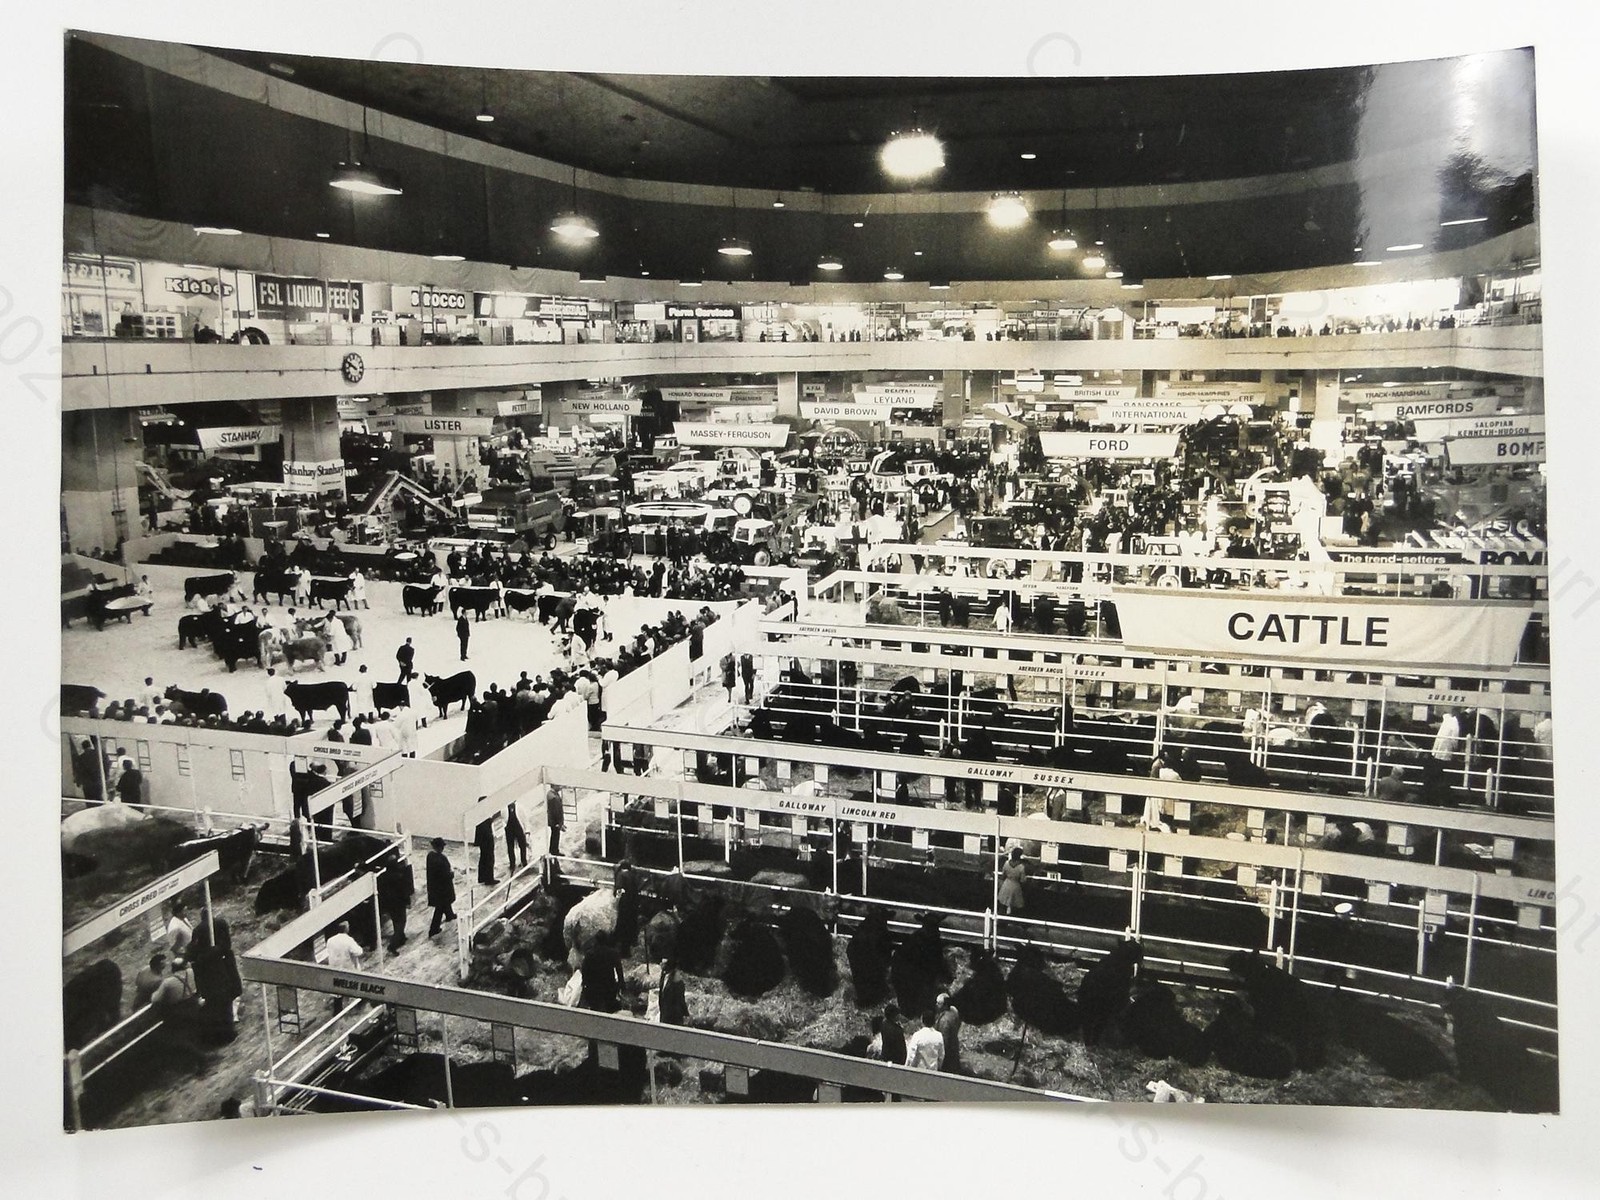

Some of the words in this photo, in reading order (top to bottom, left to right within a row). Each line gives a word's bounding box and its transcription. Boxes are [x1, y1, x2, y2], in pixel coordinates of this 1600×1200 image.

[165, 277, 233, 297] Kleber
[259, 283, 283, 306] FSL
[286, 285, 324, 308] LIQUID
[329, 288, 360, 310] FEEDS
[411, 291, 465, 308] SROCCO
[1074, 389, 1101, 397] BRITISH
[1104, 389, 1120, 397] LELY
[874, 396, 915, 405] LEYLAND
[572, 402, 590, 411] NEW
[593, 403, 630, 412] HOLLAND
[814, 407, 840, 416] DAVID
[844, 408, 878, 416] BROWN
[1396, 402, 1474, 416] BAMFORDS
[1112, 410, 1188, 419] INTERNATIONAL
[424, 419, 462, 431] LISTER
[1475, 420, 1514, 428] SALOPIAN
[221, 430, 262, 443] STANHAY
[690, 429, 771, 440] MASSEY-FERGUSON
[1089, 439, 1129, 451] FORD
[283, 463, 317, 480] Stanhay
[317, 463, 345, 478] Stanhay
[1339, 554, 1362, 564] The
[1227, 612, 1390, 647] CATTLE
[1018, 665, 1044, 673] ABERDEEN
[1074, 669, 1106, 677] SUSSEX
[1428, 693, 1467, 703] SUSSEX
[967, 767, 1014, 778] GALLOWAY
[1033, 773, 1075, 785] SUSSEX
[779, 800, 826, 813] GALLOWAY
[841, 806, 877, 818] LINCOLN
[879, 811, 896, 820] RED
[119, 898, 141, 917] CROSS
[140, 890, 158, 906] BRED
[333, 977, 359, 991] WELSH
[360, 981, 386, 996] BLACK
